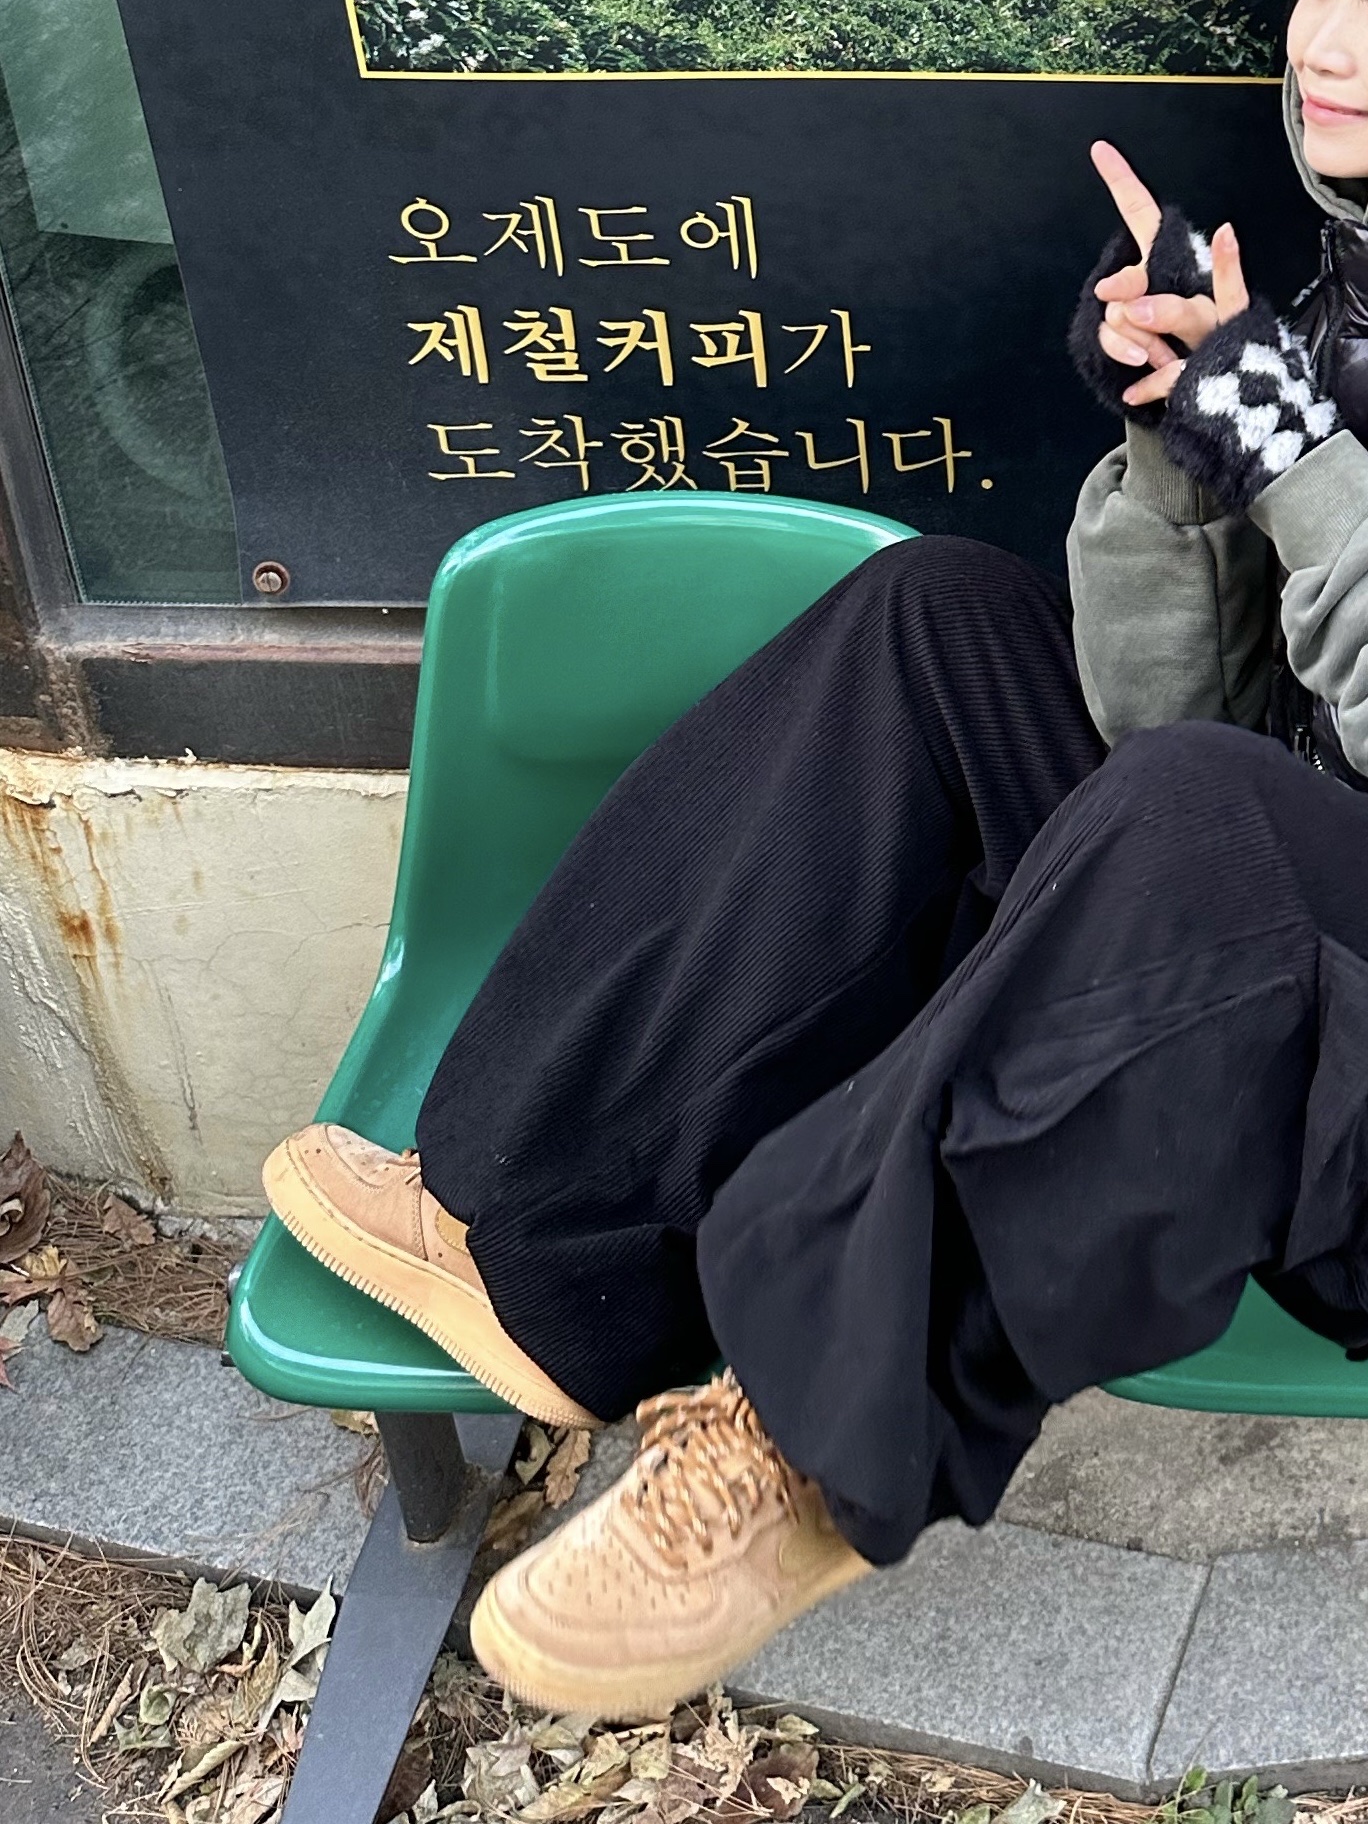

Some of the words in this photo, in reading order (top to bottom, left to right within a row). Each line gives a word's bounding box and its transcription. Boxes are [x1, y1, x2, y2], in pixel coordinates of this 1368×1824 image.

[388, 195, 758, 279] 오제도에
[407, 304, 872, 388] 제철커피가
[426, 414, 994, 493] 도착했습니다.
